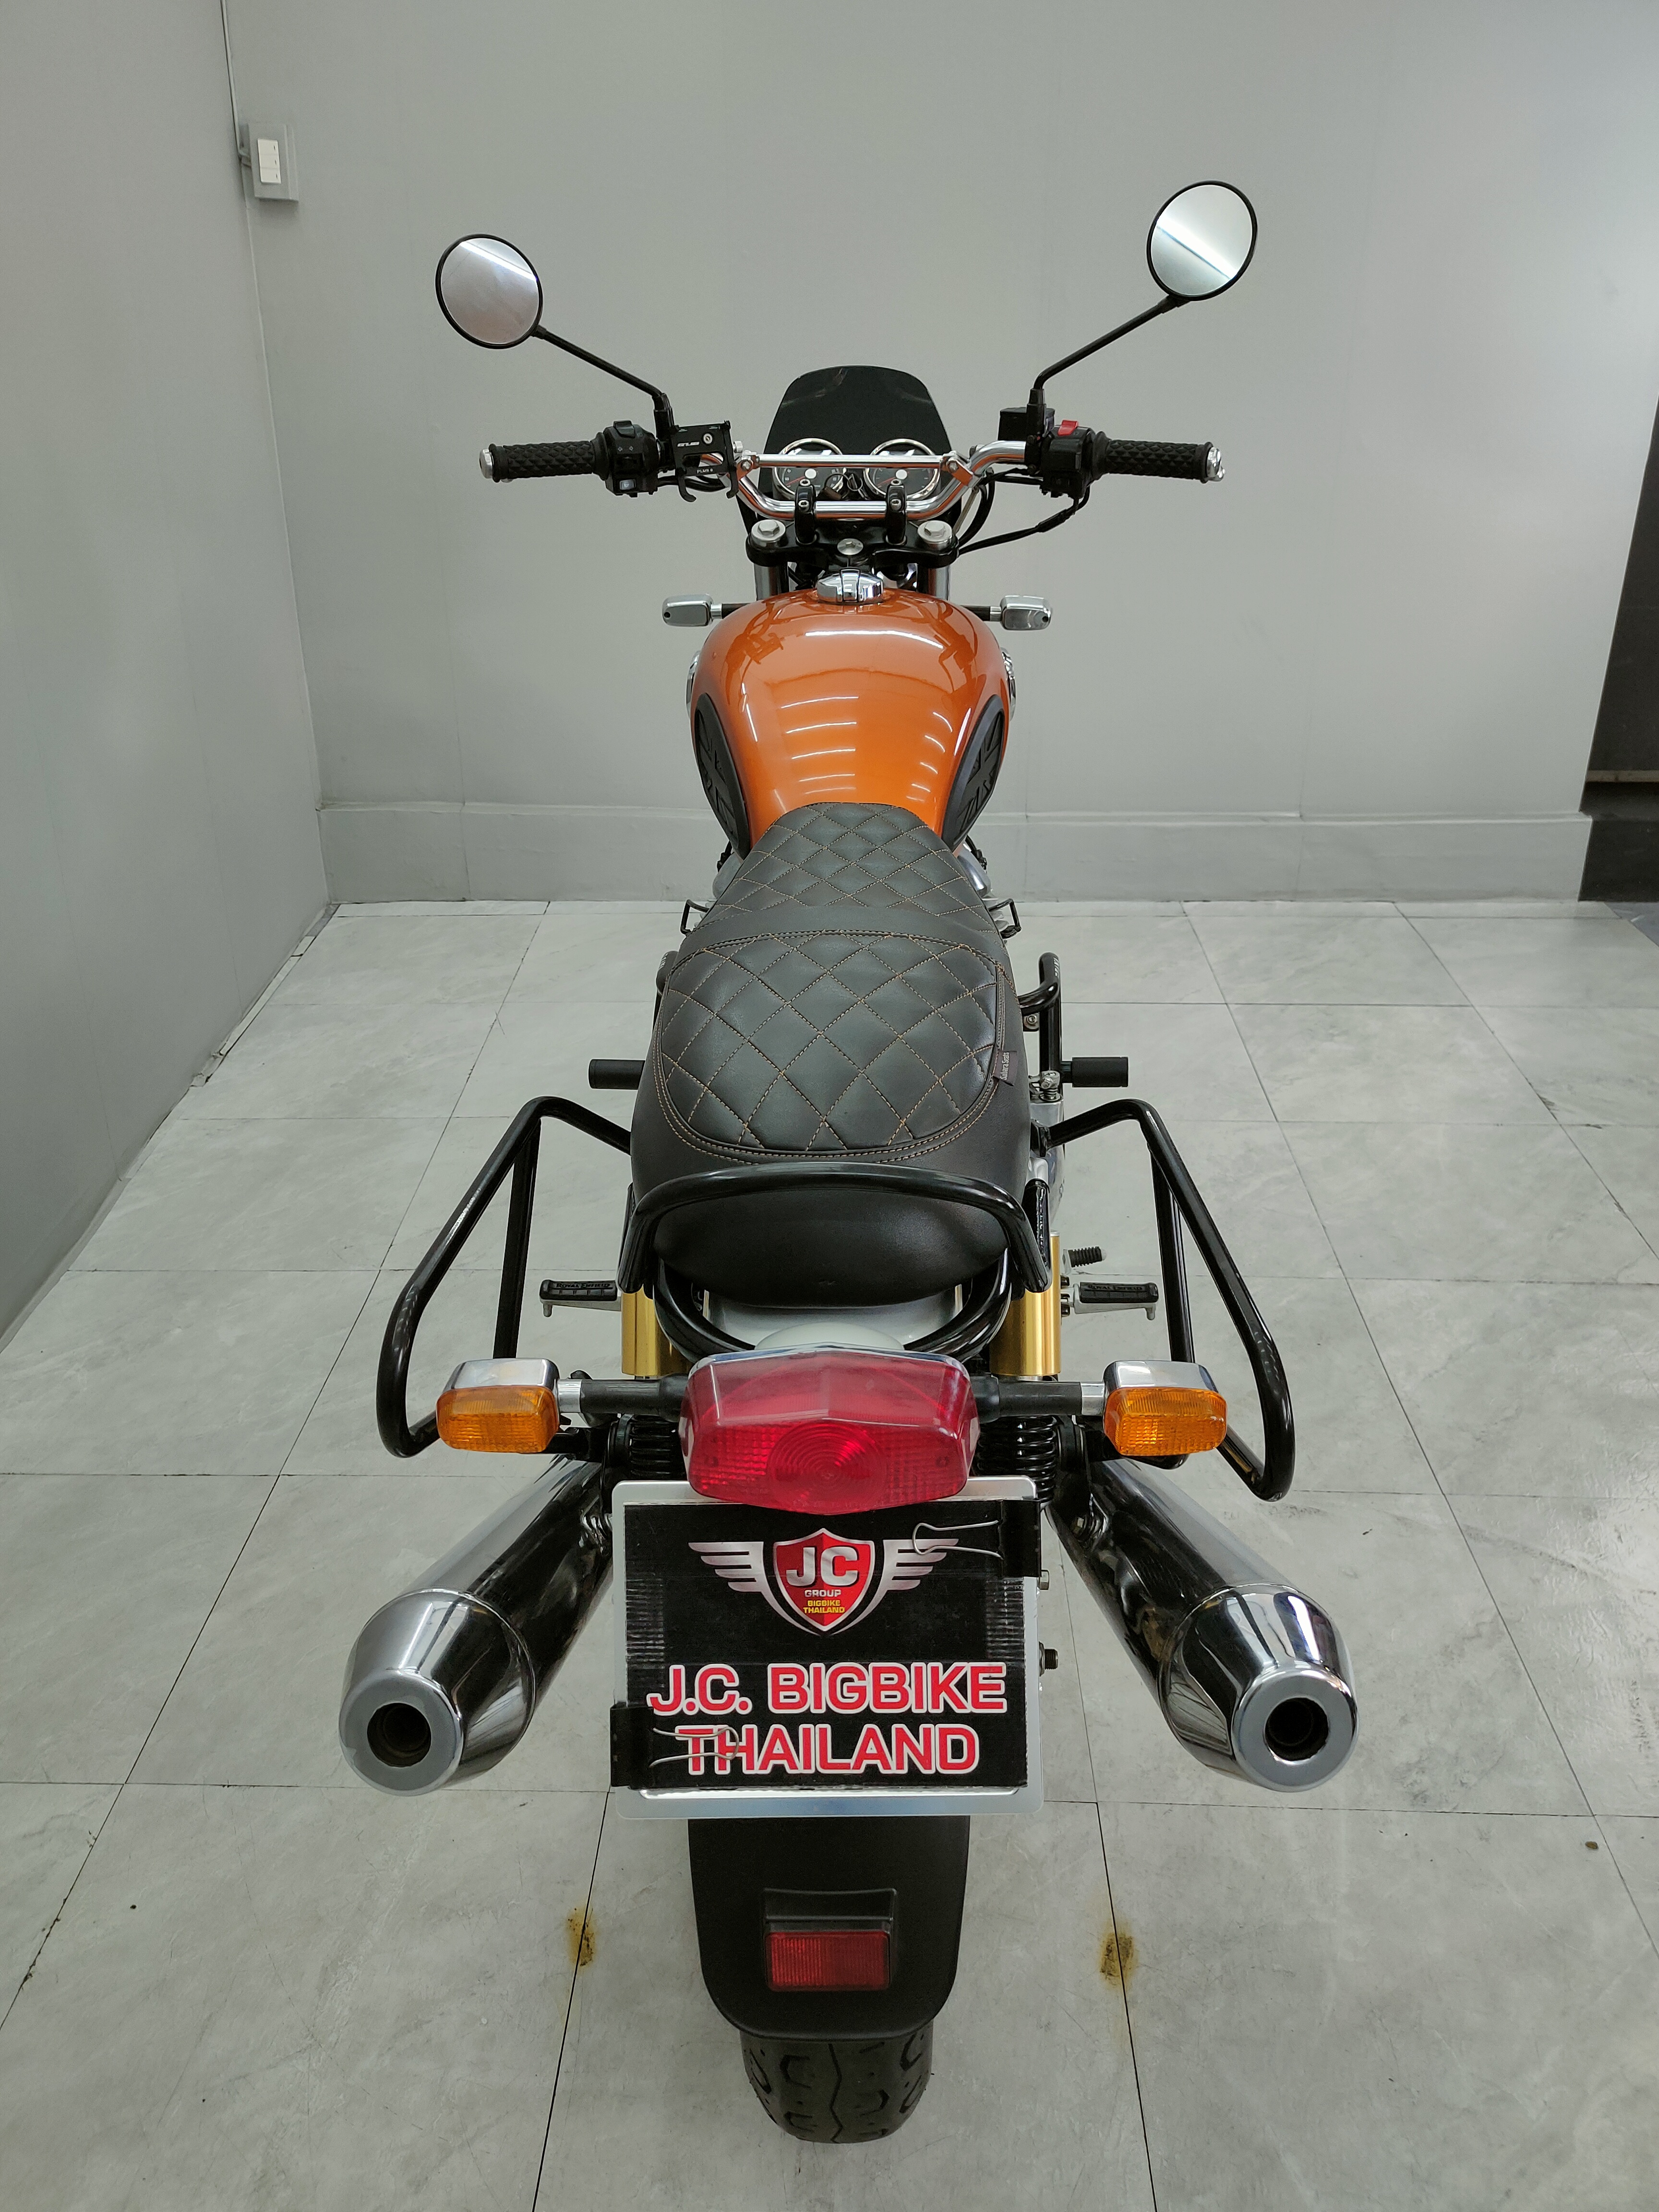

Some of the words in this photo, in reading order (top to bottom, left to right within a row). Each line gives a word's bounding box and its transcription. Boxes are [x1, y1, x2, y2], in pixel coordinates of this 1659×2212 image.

[1000, 1064, 1009, 1080] Sahara
[786, 1547, 858, 1586] JC
[647, 1664, 752, 1716] J.C.
[768, 1662, 1007, 1714] BIGBIKE
[675, 1724, 979, 1775] THAILAND
